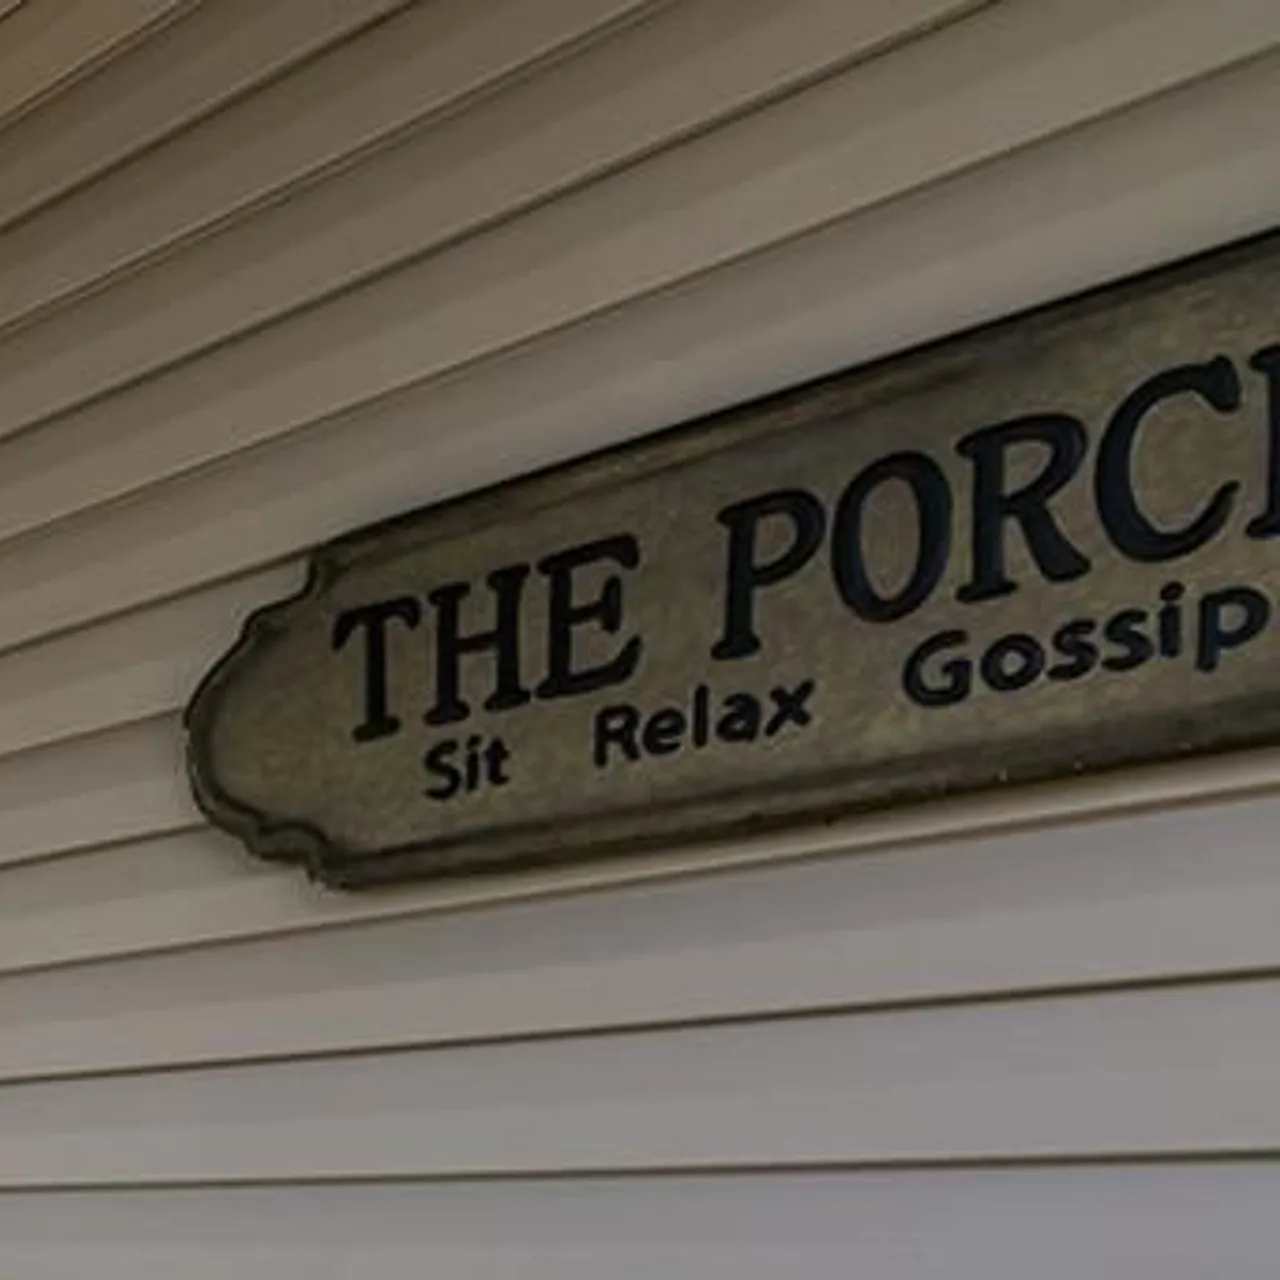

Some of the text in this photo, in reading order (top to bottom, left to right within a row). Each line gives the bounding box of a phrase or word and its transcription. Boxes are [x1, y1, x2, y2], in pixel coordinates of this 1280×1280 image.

[332, 344, 1280, 743] THE PORC
[424, 581, 1271, 800] Sit Relax Gossip
